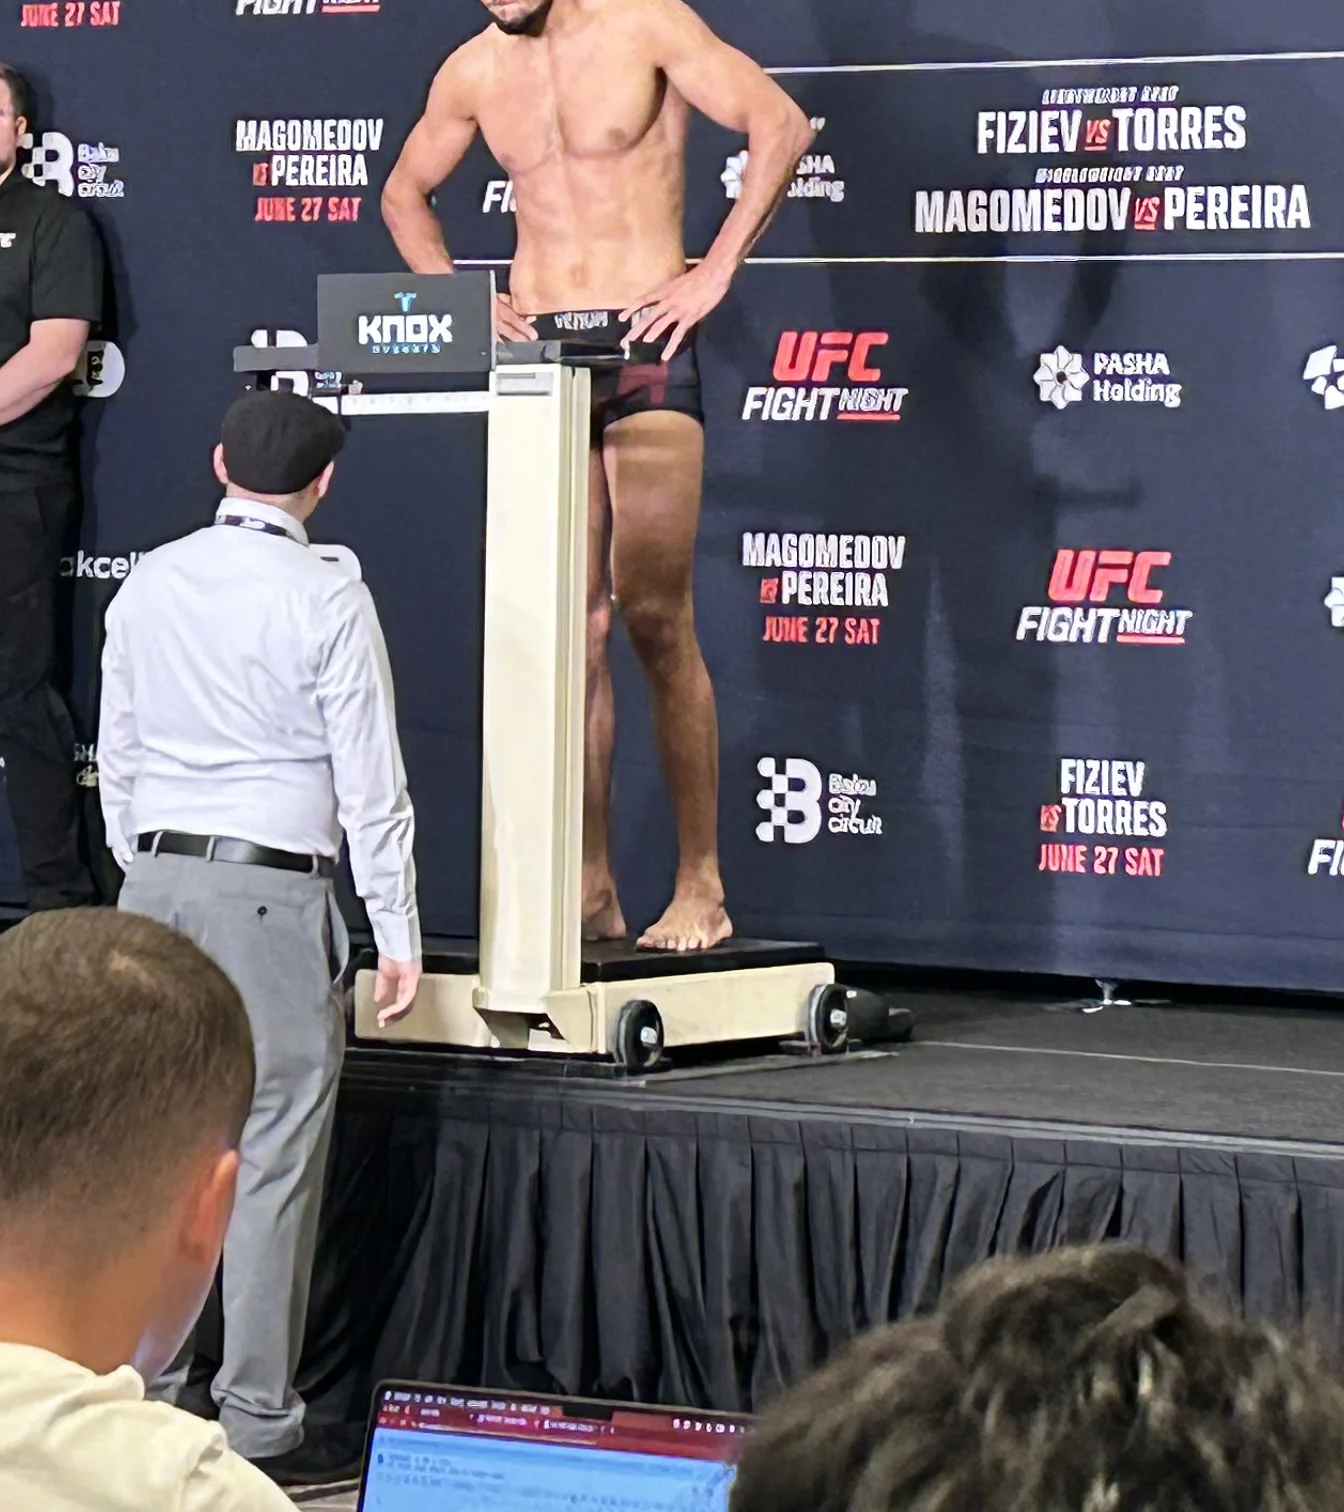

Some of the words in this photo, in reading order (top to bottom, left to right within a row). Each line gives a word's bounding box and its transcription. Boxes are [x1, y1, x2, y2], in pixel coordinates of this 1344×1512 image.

[21, 3, 58, 27] JUNE
[65, 2, 85, 27] 27
[90, 1, 121, 26] SAT
[236, 118, 384, 152] MAGOMEDOV
[977, 110, 1082, 154] FIZIEV
[1086, 119, 1110, 144] VS
[1113, 106, 1247, 152] TORRES
[272, 153, 368, 187] PEREIRA
[255, 197, 296, 222] JUNE
[301, 197, 323, 222] 27
[327, 197, 362, 222] SAT
[915, 189, 1132, 233] MAGOMEDOV
[1135, 197, 1160, 223] VS
[1164, 185, 1311, 230] PEREIRA
[358, 314, 453, 344] KNOX
[772, 331, 889, 382] UFC
[1093, 352, 1170, 376] PASHA
[742, 388, 839, 421] FIGHT
[838, 387, 909, 413] NIGHT
[1093, 379, 1182, 408] Holding
[742, 532, 906, 569] MAGOMEDOV
[781, 571, 889, 607] PEREIRA
[1048, 549, 1172, 603] UFC
[763, 616, 808, 642] JUNE
[815, 618, 838, 643] 27
[844, 618, 881, 644] SAT
[1016, 607, 1121, 642] FIGHT
[1118, 608, 1193, 635] NIGHT
[1060, 759, 1145, 796] FIZIEV
[1061, 798, 1167, 836] TORRES
[1038, 843, 1086, 872] JUNE
[1093, 846, 1118, 873] 27
[1124, 848, 1164, 876] SAT
